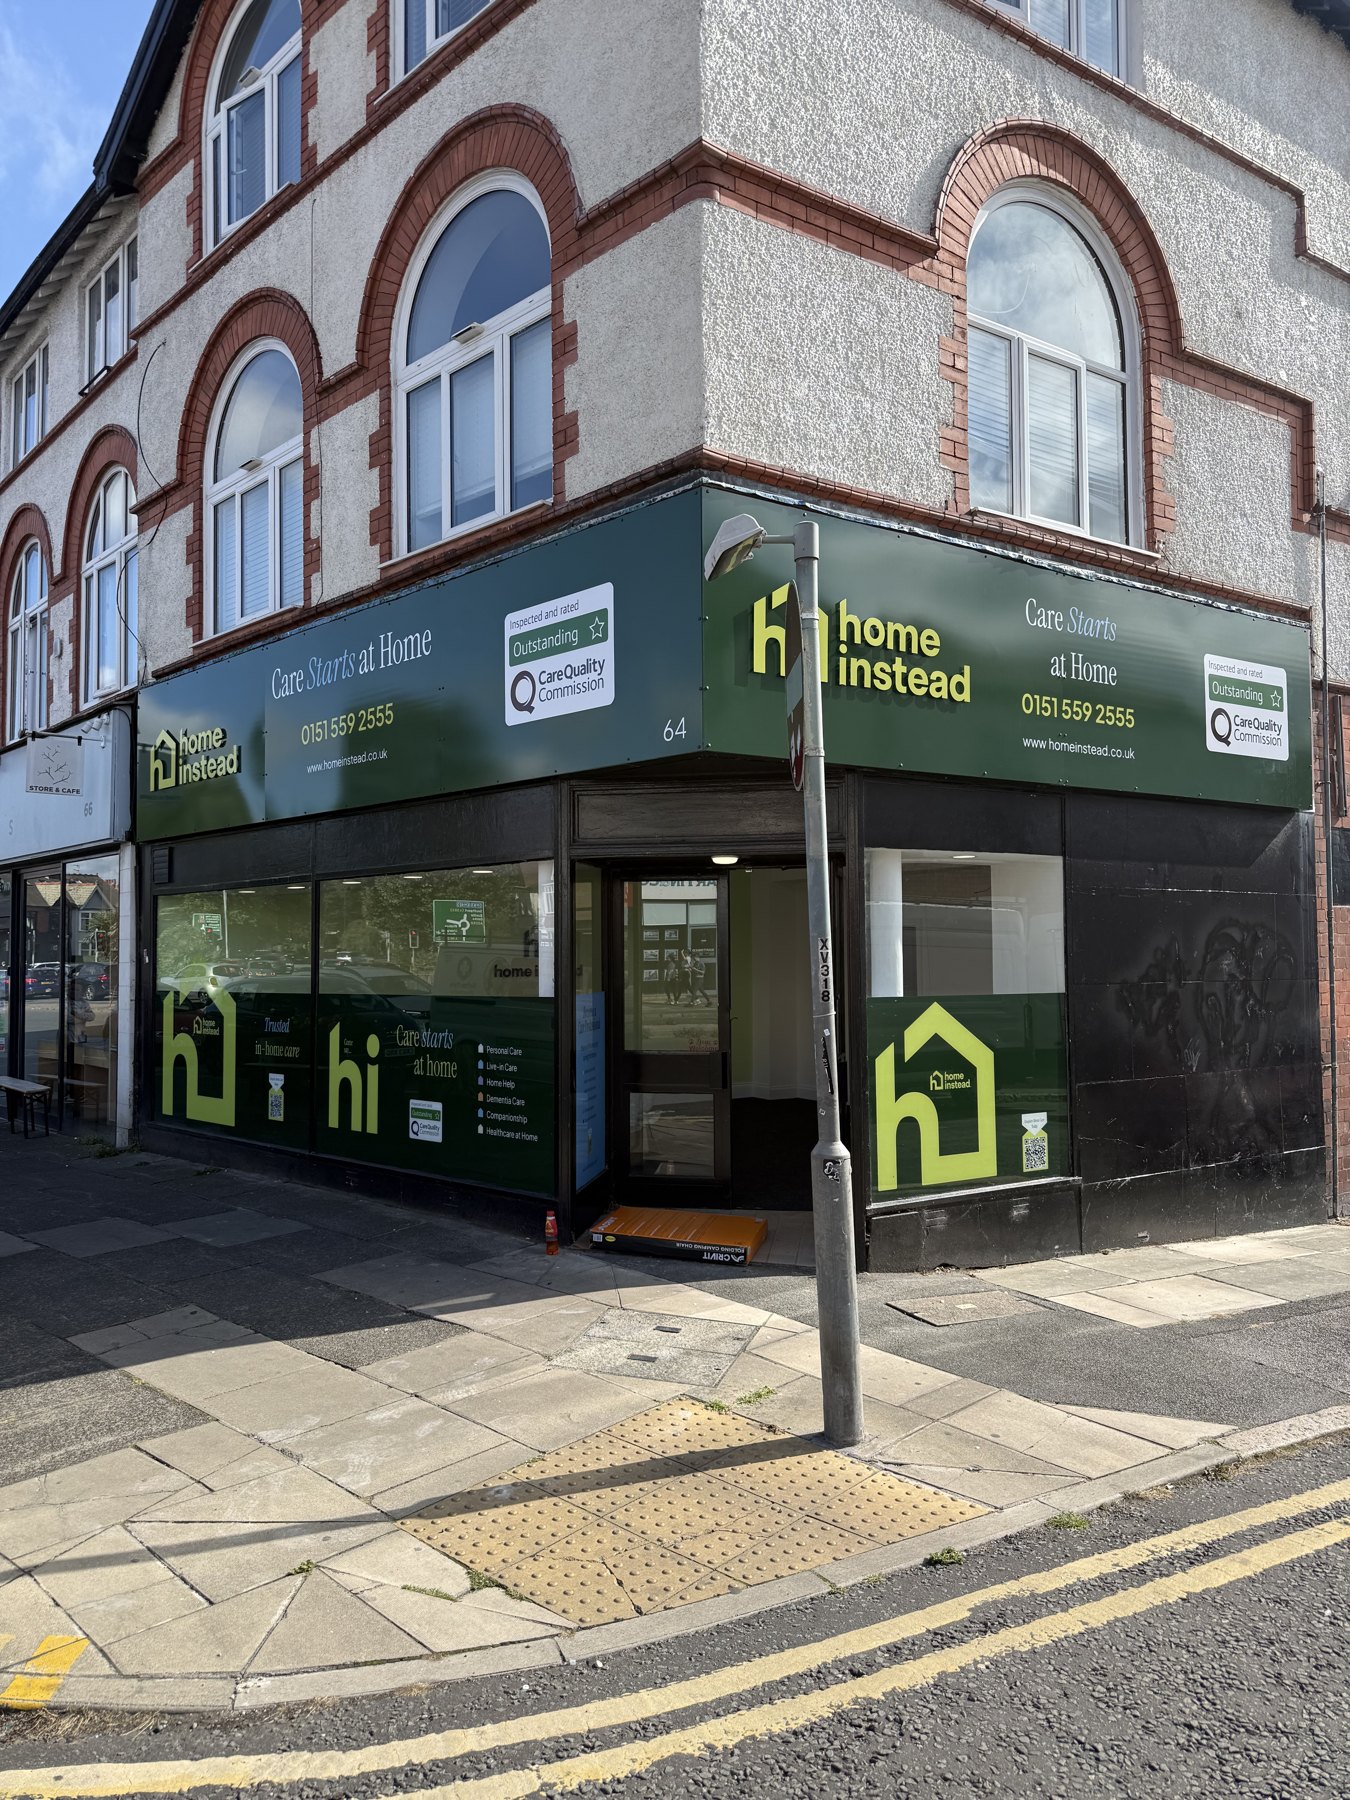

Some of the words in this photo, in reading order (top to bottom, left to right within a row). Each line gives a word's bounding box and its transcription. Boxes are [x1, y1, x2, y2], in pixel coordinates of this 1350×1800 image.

[509, 611, 543, 630] Inspected
[544, 606, 558, 619] and
[560, 600, 580, 615] rated
[1025, 597, 1064, 631] Care
[1067, 606, 1117, 641] Starts
[839, 598, 941, 657] home
[513, 628, 579, 658] Outstanding
[271, 668, 304, 699] Care
[306, 649, 356, 690] Starts
[359, 641, 376, 675] at
[379, 629, 432, 669] Home
[839, 643, 971, 703] instead
[1050, 653, 1067, 679] at
[1070, 651, 1118, 686] Home
[1208, 660, 1236, 674] Inspected
[1236, 667, 1248, 676] and
[1248, 669, 1263, 679] rated
[538, 676, 605, 703] Commission
[1212, 681, 1264, 705] Outstanding
[1021, 693, 1058, 718] 0151
[1061, 699, 1092, 722] 559
[1095, 703, 1135, 728] 2555
[301, 720, 328, 745] 0151
[330, 712, 356, 738] 559
[358, 702, 394, 732] 2555
[663, 716, 687, 742] 64
[179, 727, 224, 756] home
[1233, 728, 1282, 747] Commission
[179, 744, 238, 785] instead
[29, 785, 53, 793] STORE
[84, 801, 93, 817] 66
[494, 964, 532, 978] home
[264, 1017, 291, 1033] Trusted
[396, 1024, 420, 1047] Care
[421, 1027, 454, 1049] starts
[255, 1041, 284, 1056] in-home
[284, 1046, 300, 1058] care
[486, 1045, 509, 1055] Personal
[509, 1047, 523, 1056] Care
[413, 1056, 425, 1076] at
[426, 1054, 457, 1078] home
[486, 1062, 504, 1071] Live-in
[504, 1063, 518, 1072] Care
[328, 1021, 380, 1135] hi
[486, 1078, 502, 1087] Home
[502, 1079, 515, 1090] Help
[944, 1071, 965, 1081] home
[944, 1079, 971, 1090] instead
[486, 1094, 512, 1105] Dementia
[512, 1097, 525, 1106] Care
[486, 1110, 528, 1125] Companionship
[486, 1127, 515, 1139] Healthcare
[515, 1131, 521, 1139] at
[521, 1132, 538, 1142] Home
[693, 1244, 720, 1252] CAMPING
[702, 1251, 731, 1262] CRIVIT
[720, 1246, 745, 1254] FOLDING
